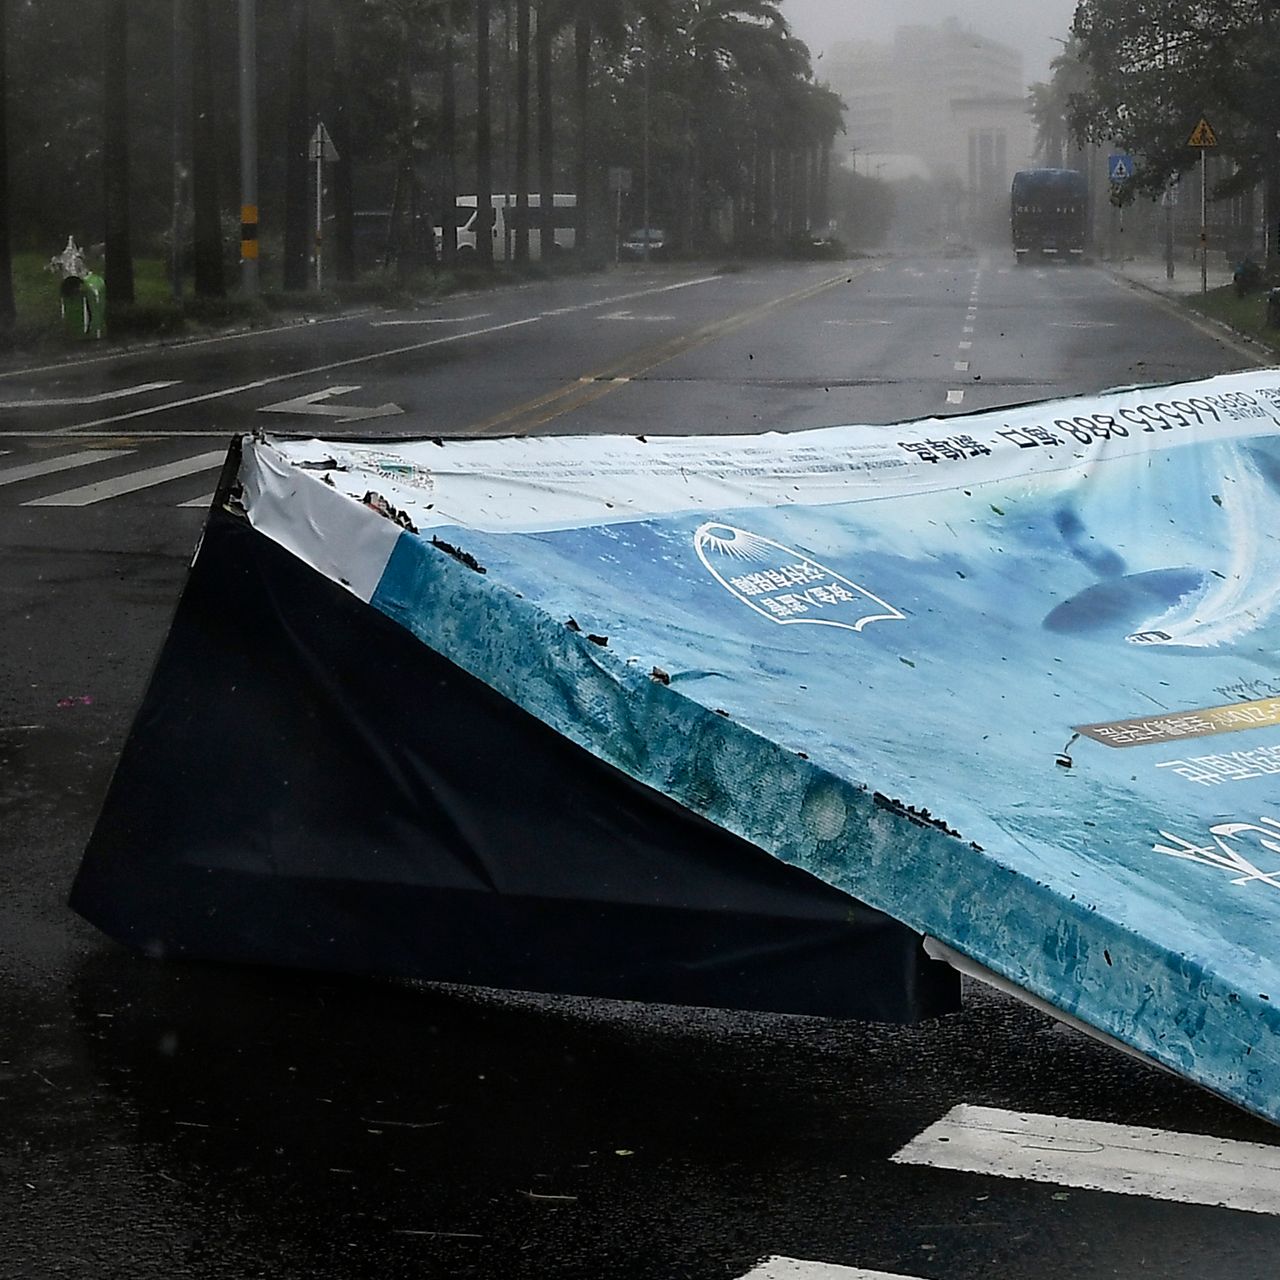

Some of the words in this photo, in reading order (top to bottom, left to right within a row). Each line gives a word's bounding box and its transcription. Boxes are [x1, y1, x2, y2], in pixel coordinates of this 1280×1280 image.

[1119, 398, 1220, 433] 66555
[1215, 392, 1258, 410] 0898
[1052, 413, 1128, 445] 888
[730, 561, 825, 596] 交付有保障
[760, 582, 858, 617] 资金人监管
